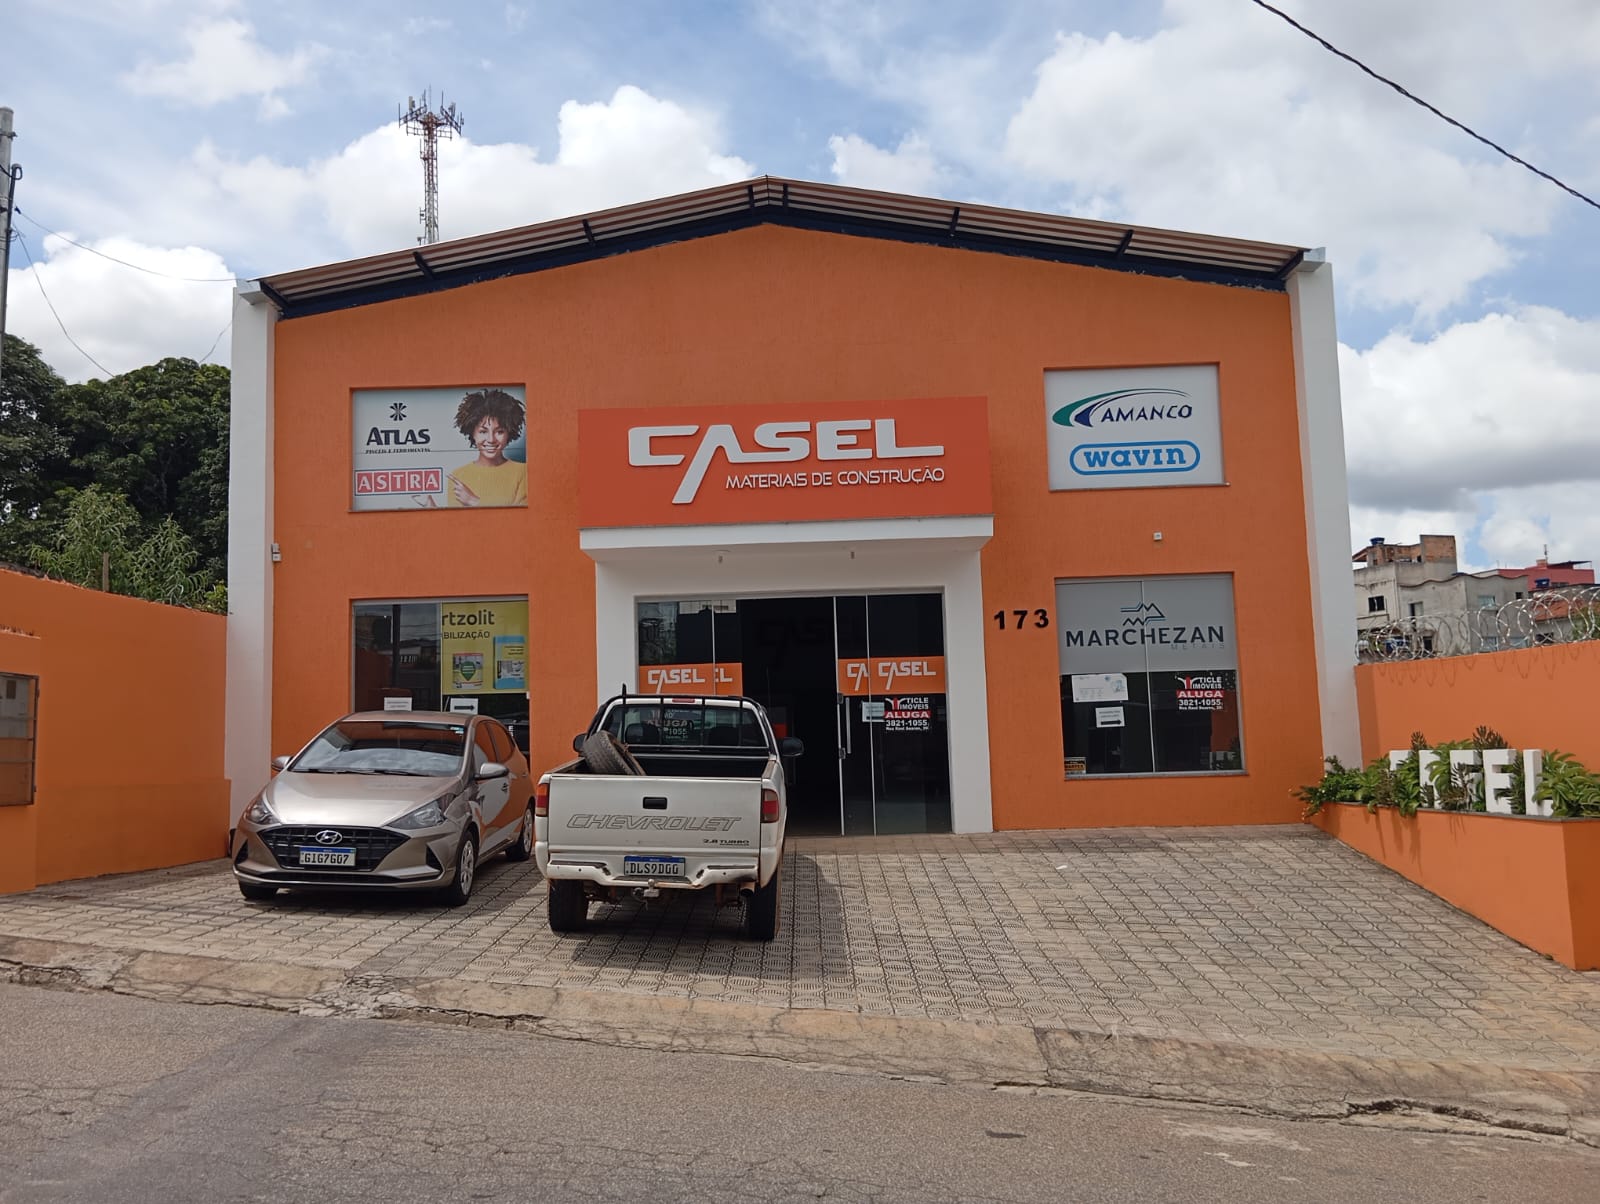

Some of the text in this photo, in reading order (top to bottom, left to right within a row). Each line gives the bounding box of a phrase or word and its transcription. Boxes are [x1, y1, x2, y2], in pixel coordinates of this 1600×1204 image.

[1100, 404, 1193, 423] AMANCO
[366, 426, 431, 446] ATLAS
[627, 418, 945, 504] CASEL
[1083, 447, 1187, 468] wavin
[357, 471, 441, 491] ASTRA
[726, 465, 945, 489] MATERIAIS DE CONSTRUÇÃO
[993, 608, 1049, 630] 173
[1065, 625, 1225, 648] MARCHEZAN
[647, 668, 706, 695] CASEL
[878, 661, 937, 690] CASEL
[1178, 690, 1224, 698] ALUGA
[885, 711, 930, 719] ALUGA
[566, 813, 742, 832] CHEVROLET
